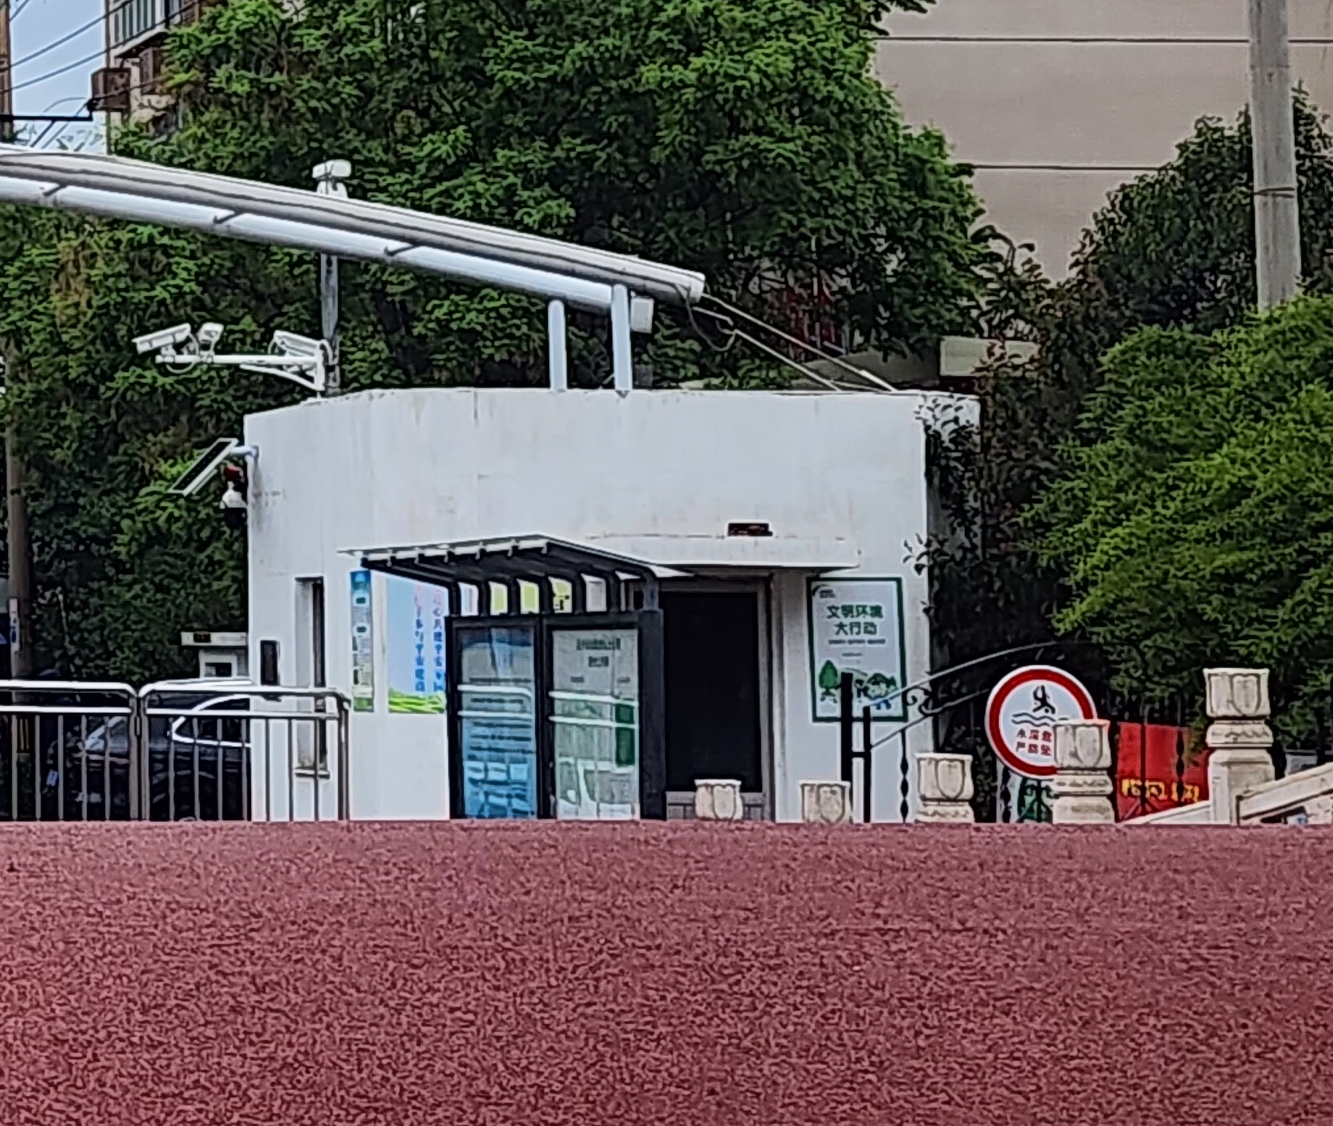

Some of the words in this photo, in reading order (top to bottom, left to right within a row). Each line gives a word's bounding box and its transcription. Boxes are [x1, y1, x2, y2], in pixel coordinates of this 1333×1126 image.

[826, 604, 884, 619] 文明环境
[833, 621, 878, 635] 大行动
